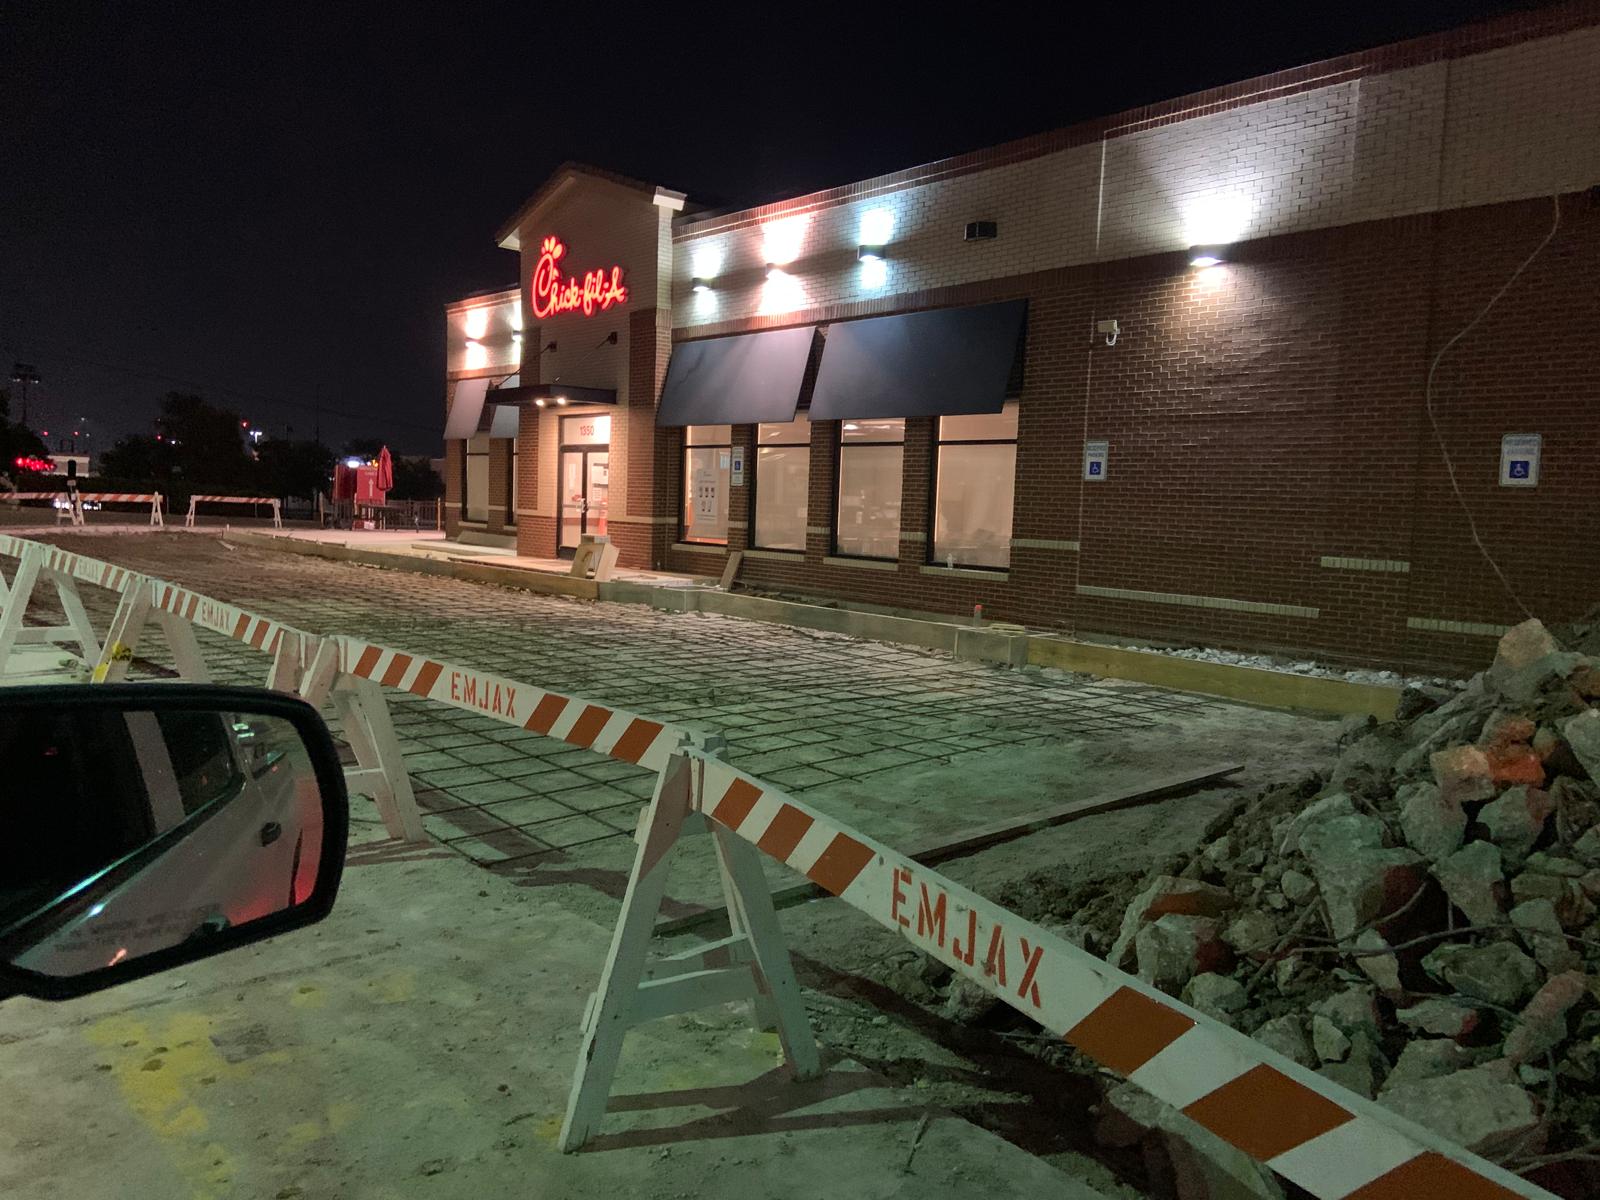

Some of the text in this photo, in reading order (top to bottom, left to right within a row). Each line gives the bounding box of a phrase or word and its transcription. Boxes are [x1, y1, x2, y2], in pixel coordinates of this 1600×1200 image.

[532, 236, 625, 318] Chick-fil-A
[580, 425, 594, 436] 1350
[201, 600, 231, 632] EMJAX
[451, 671, 516, 718] EMJAX
[891, 867, 1044, 1009] EMJAX
